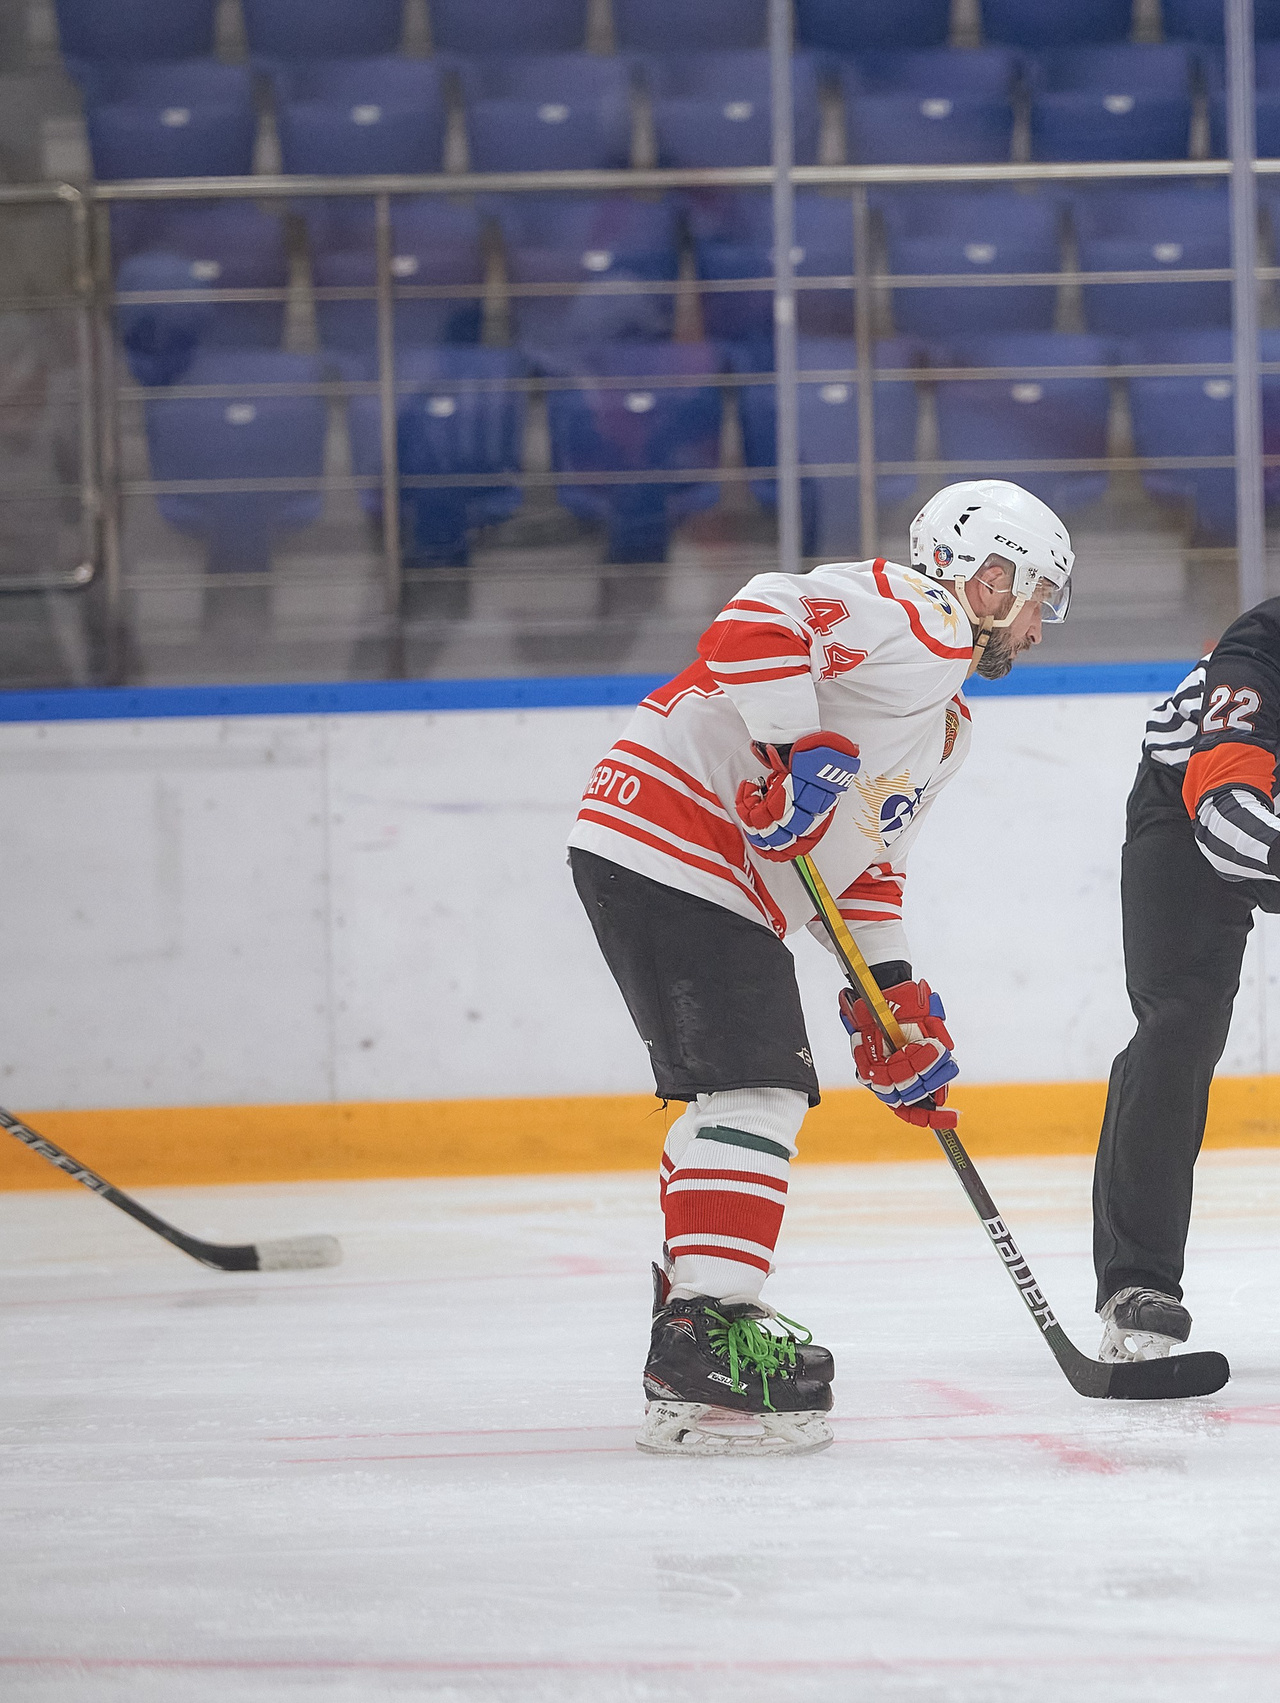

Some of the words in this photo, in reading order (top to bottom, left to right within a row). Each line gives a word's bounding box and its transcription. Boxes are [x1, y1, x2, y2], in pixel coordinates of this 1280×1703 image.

[993, 534, 1029, 555] CCM
[1201, 684, 1262, 735] 22
[983, 1214, 1058, 1332] BAUER
